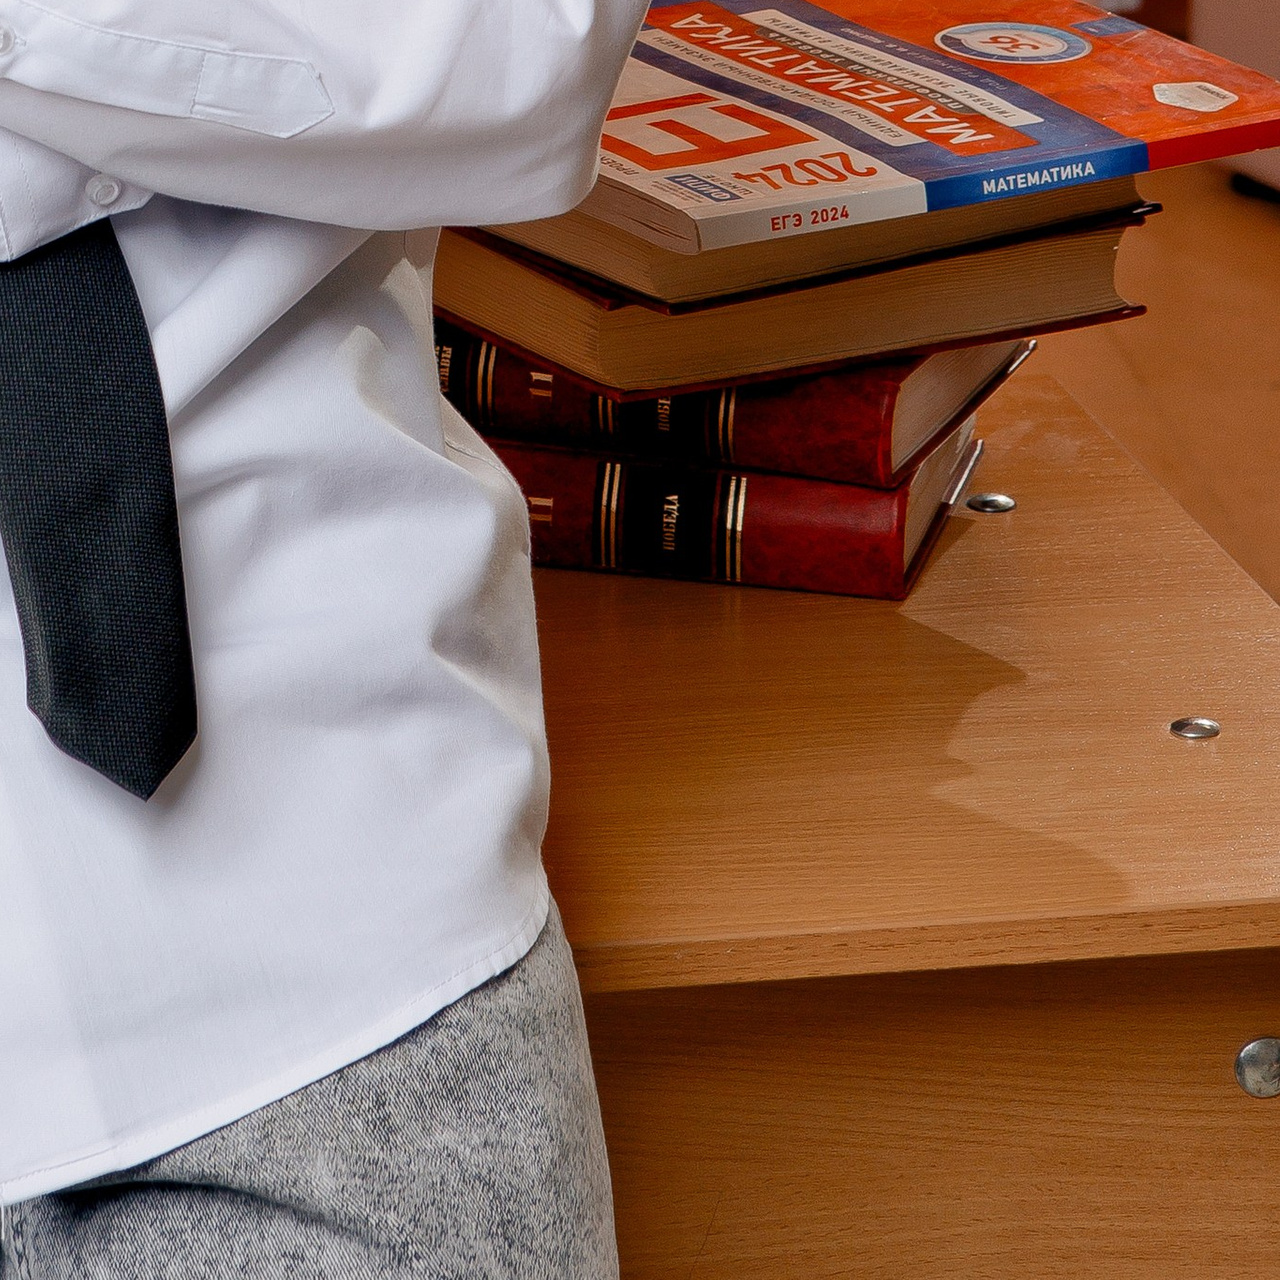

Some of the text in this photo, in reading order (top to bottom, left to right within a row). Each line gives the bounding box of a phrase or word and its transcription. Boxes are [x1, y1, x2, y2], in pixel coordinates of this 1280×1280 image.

[980, 35, 1040, 54] 36
[650, 35, 905, 137] ЕДИНЫЙ ГОСУДАРСТВЕННЫЙ ЭКЗАМЕН
[666, 12, 999, 144] МАТЕМАТИКА
[762, 17, 1019, 118] ТИПОВЫЕ ЭКЗАМЕНАЦИОННЫЕ ВАРИАНТЫ
[762, 32, 966, 108] ПРОФИЛЬНЫЙ УРОВЕНЬ
[672, 176, 731, 199] ФИПИ
[732, 152, 878, 191] 2024
[982, 160, 1096, 197] МАТЕМАТИКА
[770, 205, 850, 232] ЕГЭ 2024
[529, 372, 554, 398] 11
[662, 494, 680, 551] ПОБЕДА
